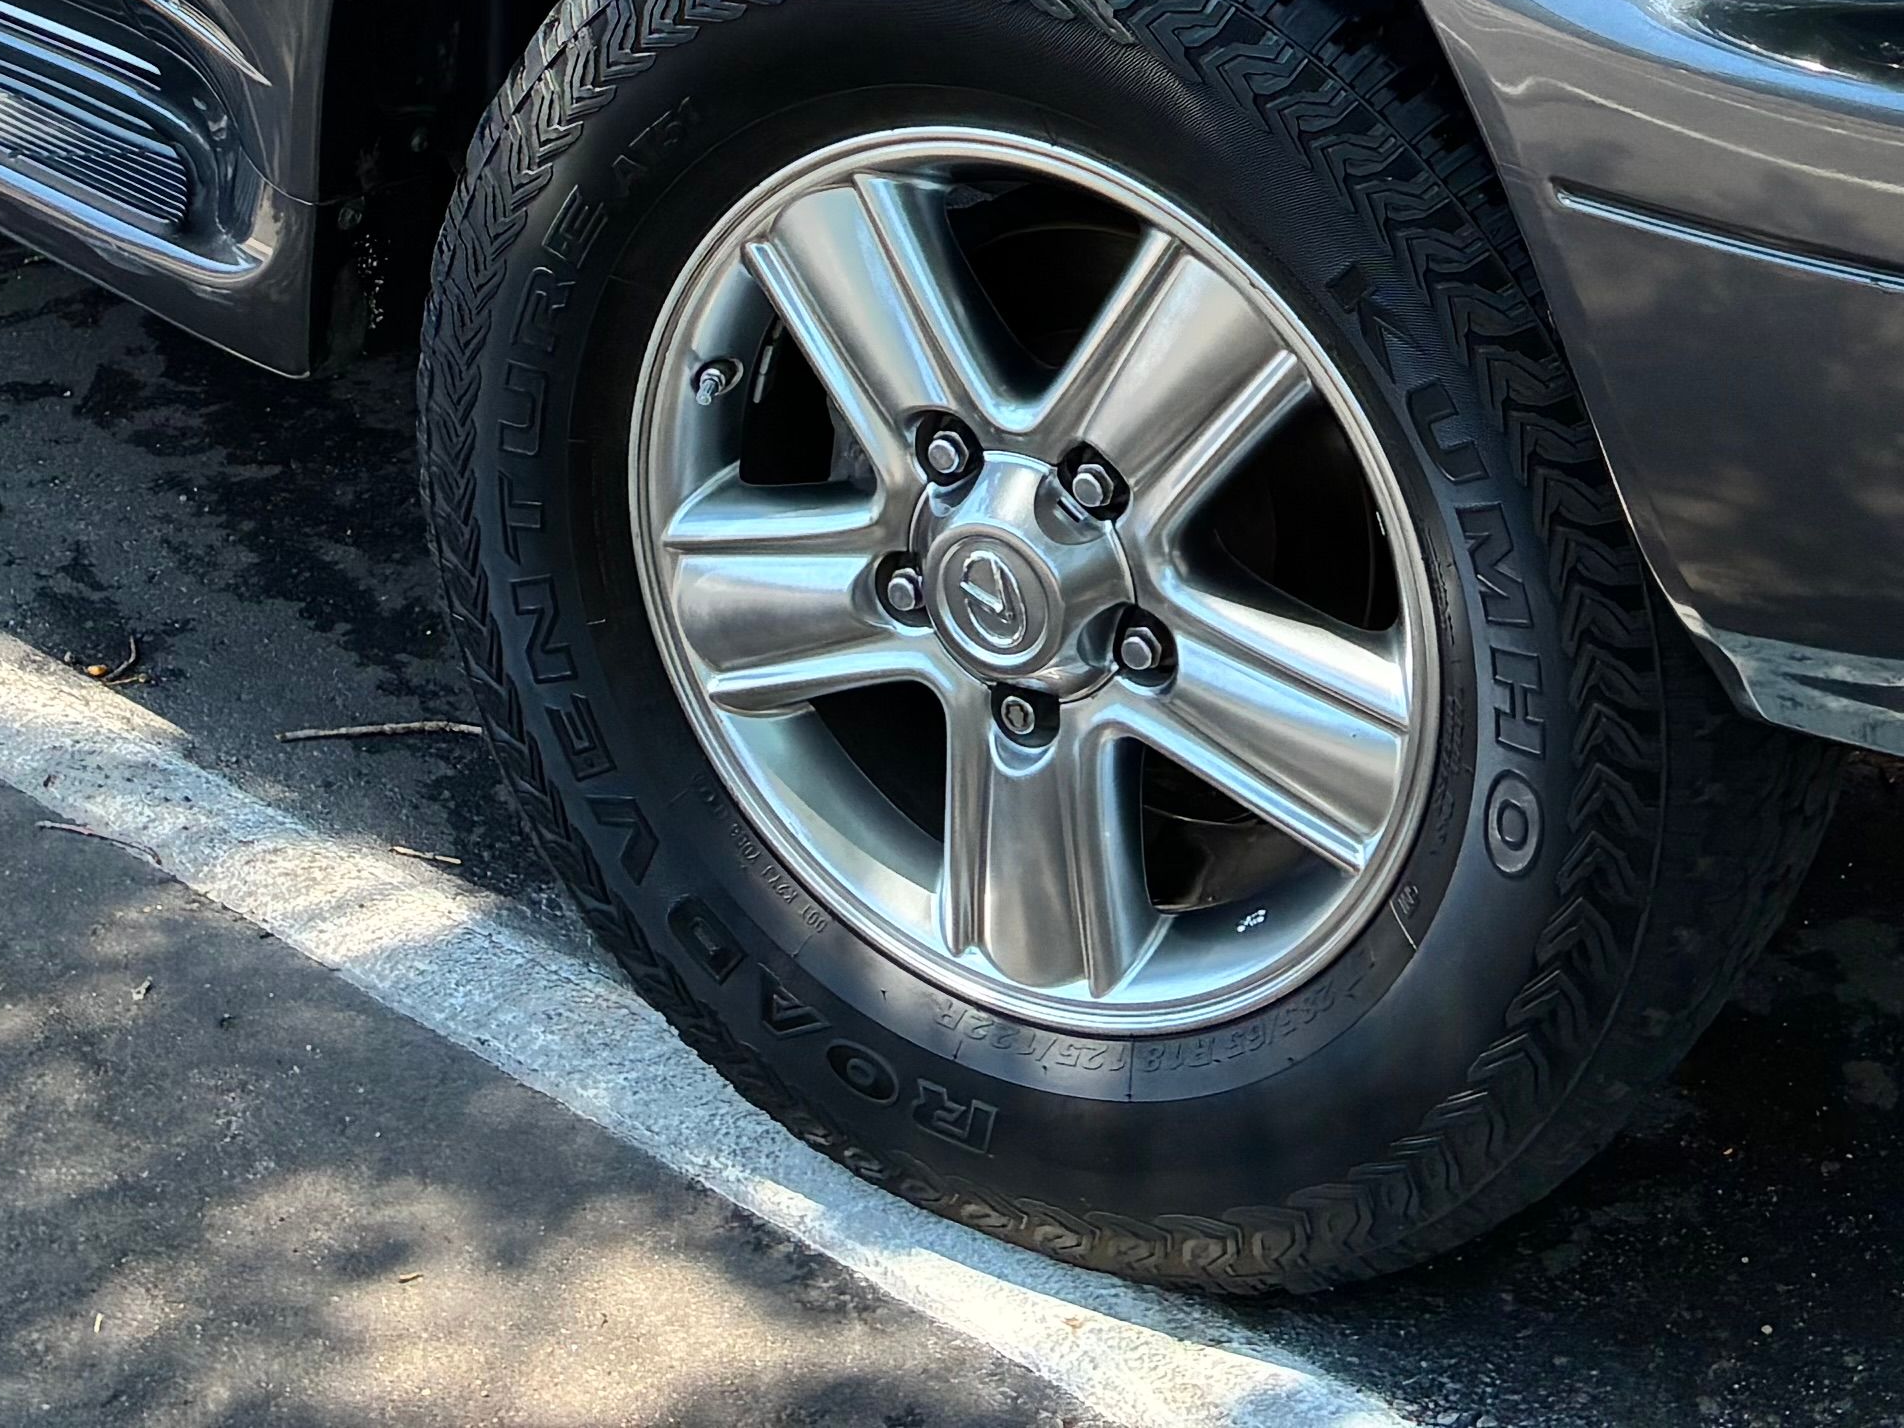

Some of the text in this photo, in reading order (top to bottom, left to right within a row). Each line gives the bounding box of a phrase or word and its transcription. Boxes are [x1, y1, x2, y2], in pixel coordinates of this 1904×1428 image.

[496, 182, 659, 887] VENTURE
[1324, 261, 1546, 878] KUMHO
[667, 891, 1000, 1156] ROAD
